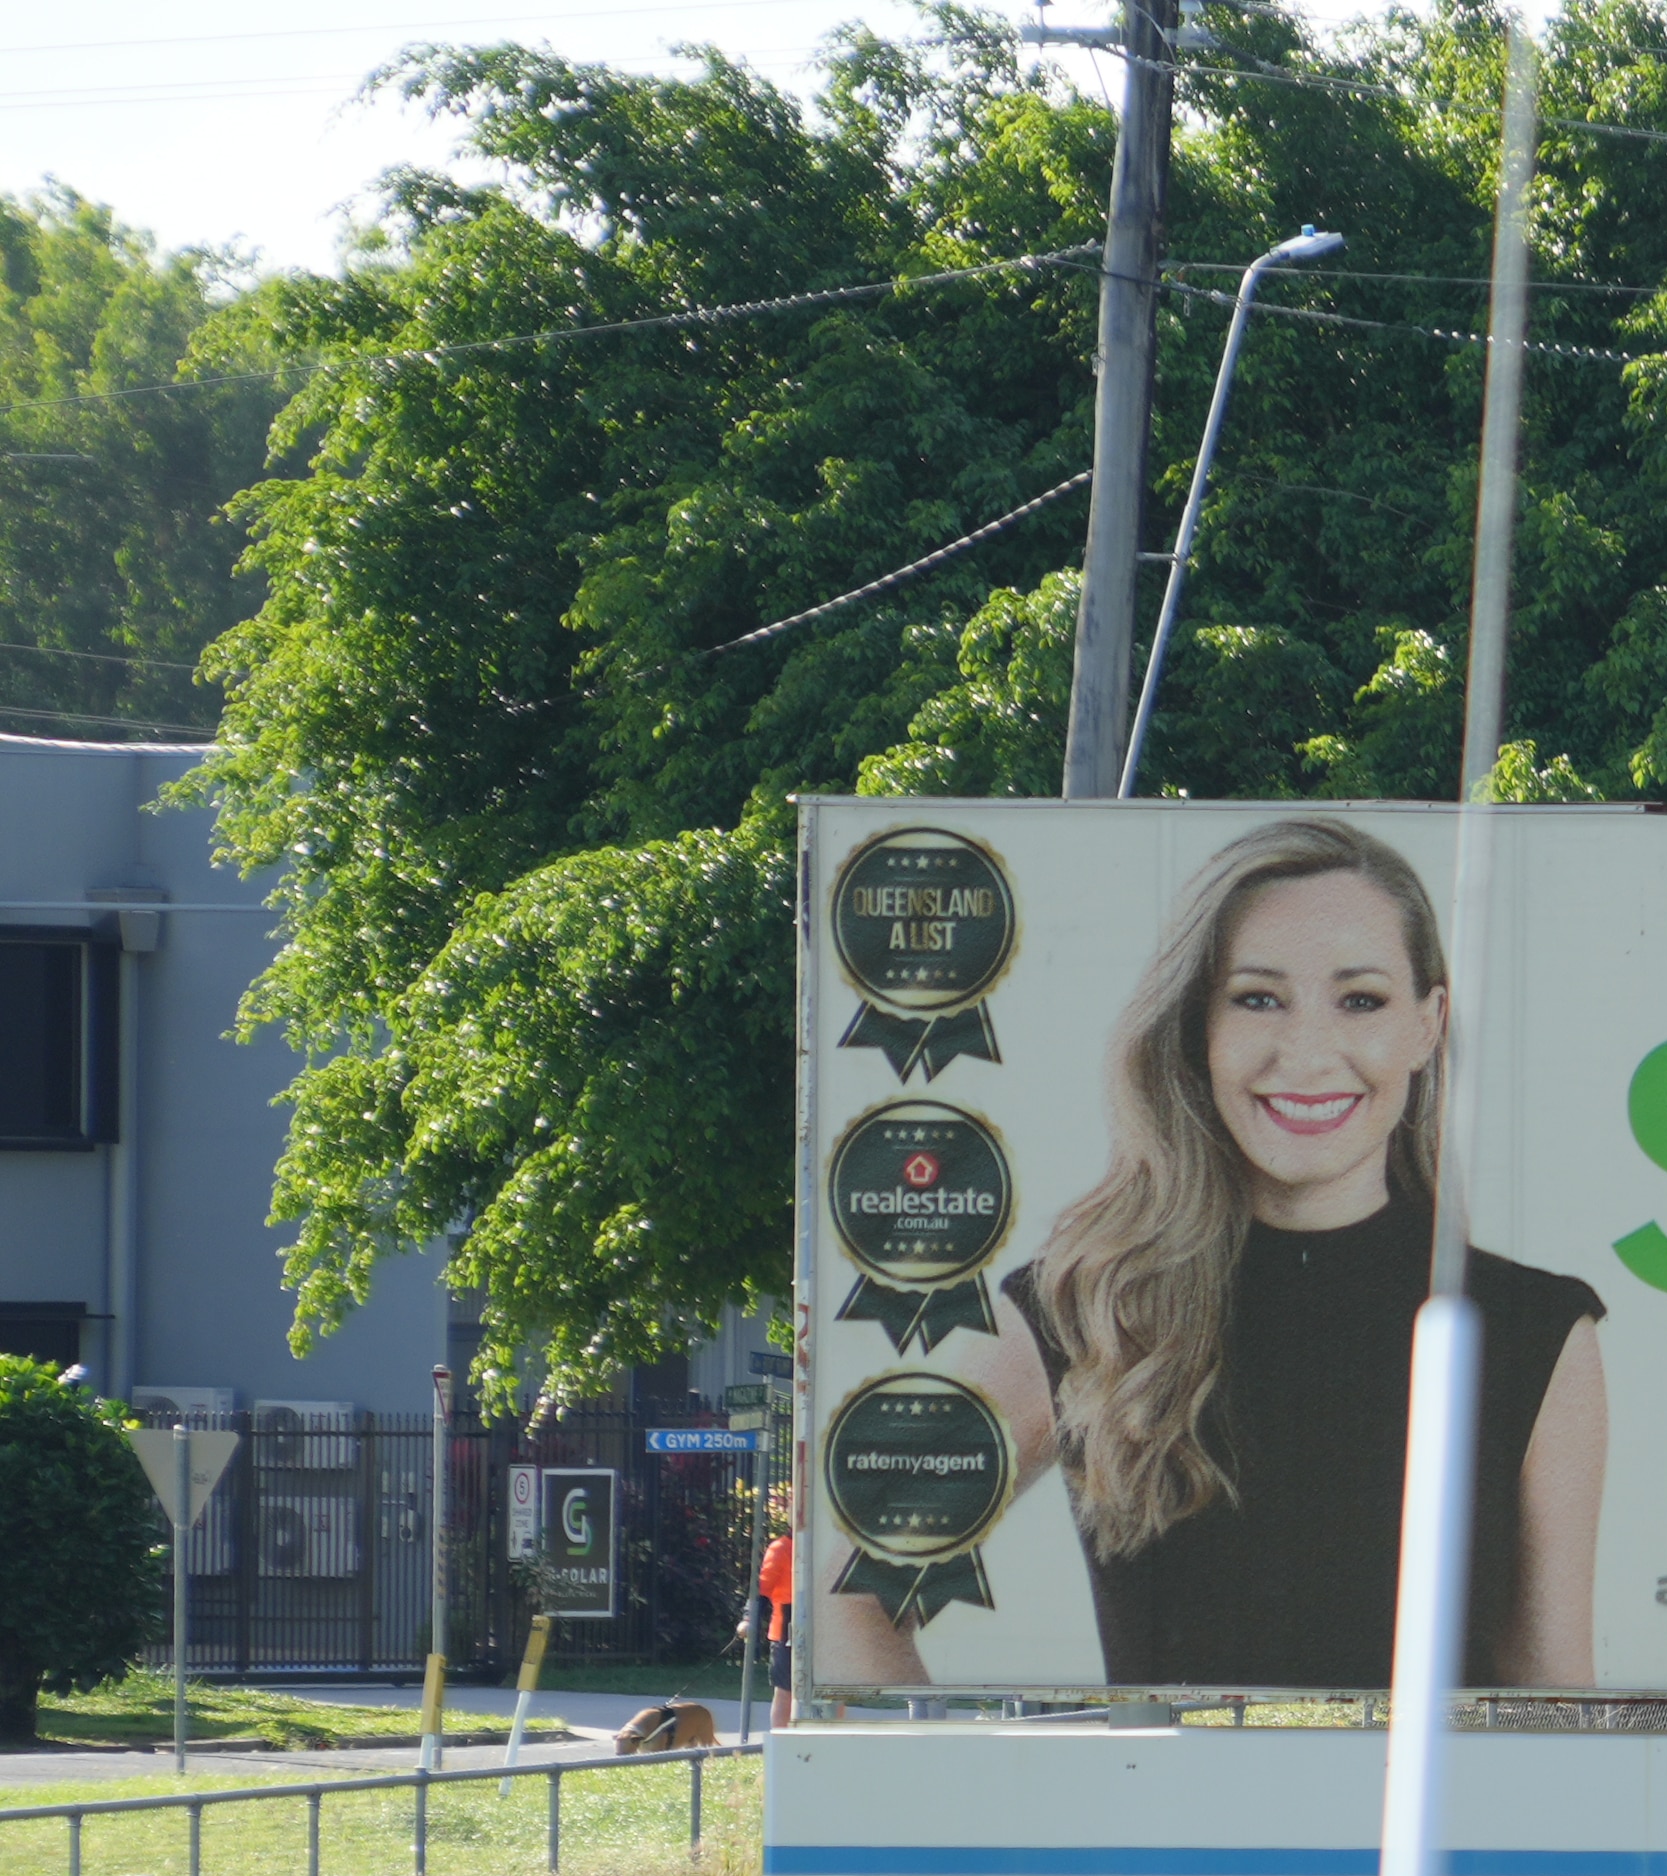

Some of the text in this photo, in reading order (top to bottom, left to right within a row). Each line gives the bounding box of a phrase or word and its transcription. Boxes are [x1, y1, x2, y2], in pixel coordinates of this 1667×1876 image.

[853, 887, 995, 918] QUEENSLAND
[889, 922, 956, 951] A LIST
[849, 1185, 995, 1214] realestate
[665, 1433, 747, 1448] GYM 250m
[846, 1452, 986, 1477] ratemyagent
